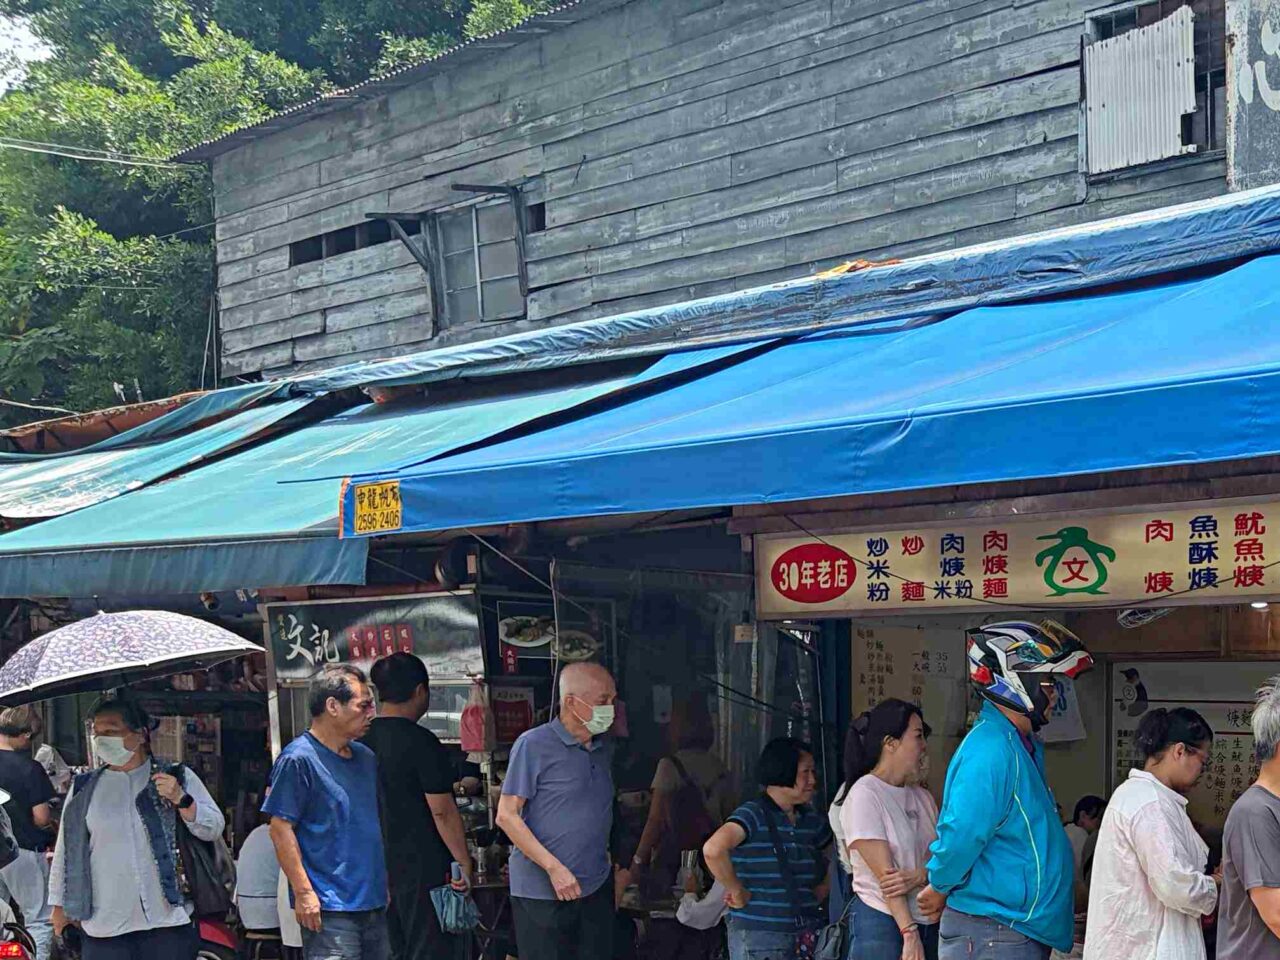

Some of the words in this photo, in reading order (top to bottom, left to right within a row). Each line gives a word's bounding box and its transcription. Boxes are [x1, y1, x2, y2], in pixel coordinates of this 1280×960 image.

[357, 510, 400, 531] 2596-2406
[1188, 515, 1218, 591] 魚酥焿
[1233, 512, 1265, 588] 魷魚焿
[779, 558, 849, 592] 30年老店
[866, 537, 890, 602] 炒米粉
[901, 536, 926, 602] 炒麵
[982, 530, 1009, 599] 肉焿麵
[1062, 557, 1089, 583] 文
